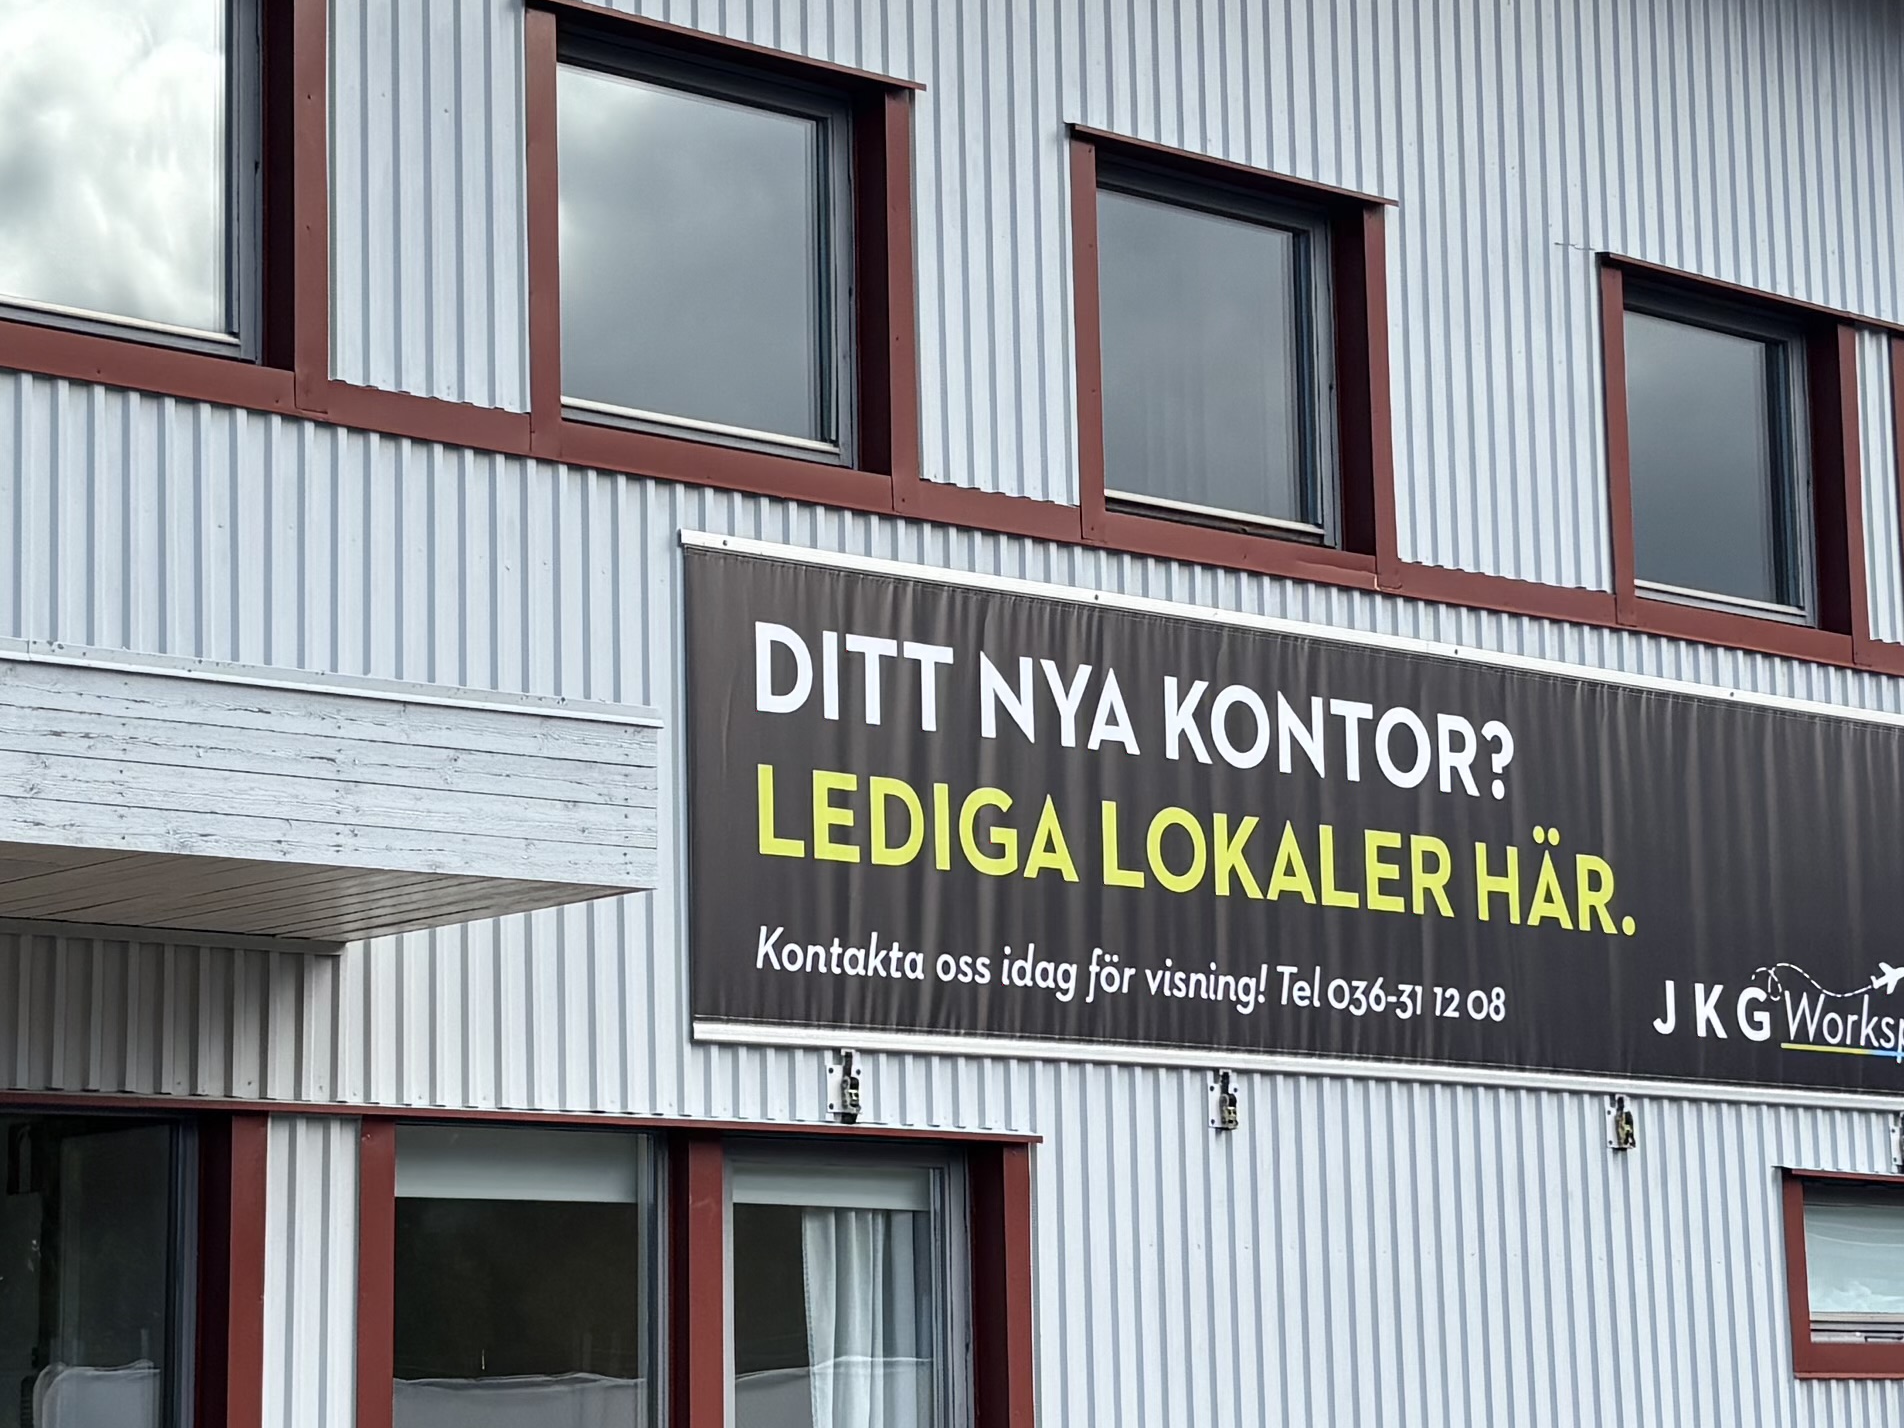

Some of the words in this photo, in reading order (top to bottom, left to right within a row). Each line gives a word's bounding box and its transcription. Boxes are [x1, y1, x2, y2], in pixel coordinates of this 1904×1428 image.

[755, 620, 954, 732] DITT
[979, 650, 1141, 756] NYA
[1163, 675, 1515, 800] KONTOR?
[757, 763, 1080, 883] LEDIGA
[1101, 800, 1455, 918] LOKALER
[1475, 825, 1636, 936] HÄR.
[756, 925, 925, 980] Kontakta
[936, 953, 991, 984] oss
[1001, 942, 1077, 1002] idag
[1085, 947, 1136, 1003] för
[1145, 958, 1268, 1015] visning!
[1276, 965, 1321, 1008] Tel
[1327, 976, 1423, 1019] 036-31
[1433, 986, 1460, 1018] 12
[1466, 987, 1506, 1022] 08
